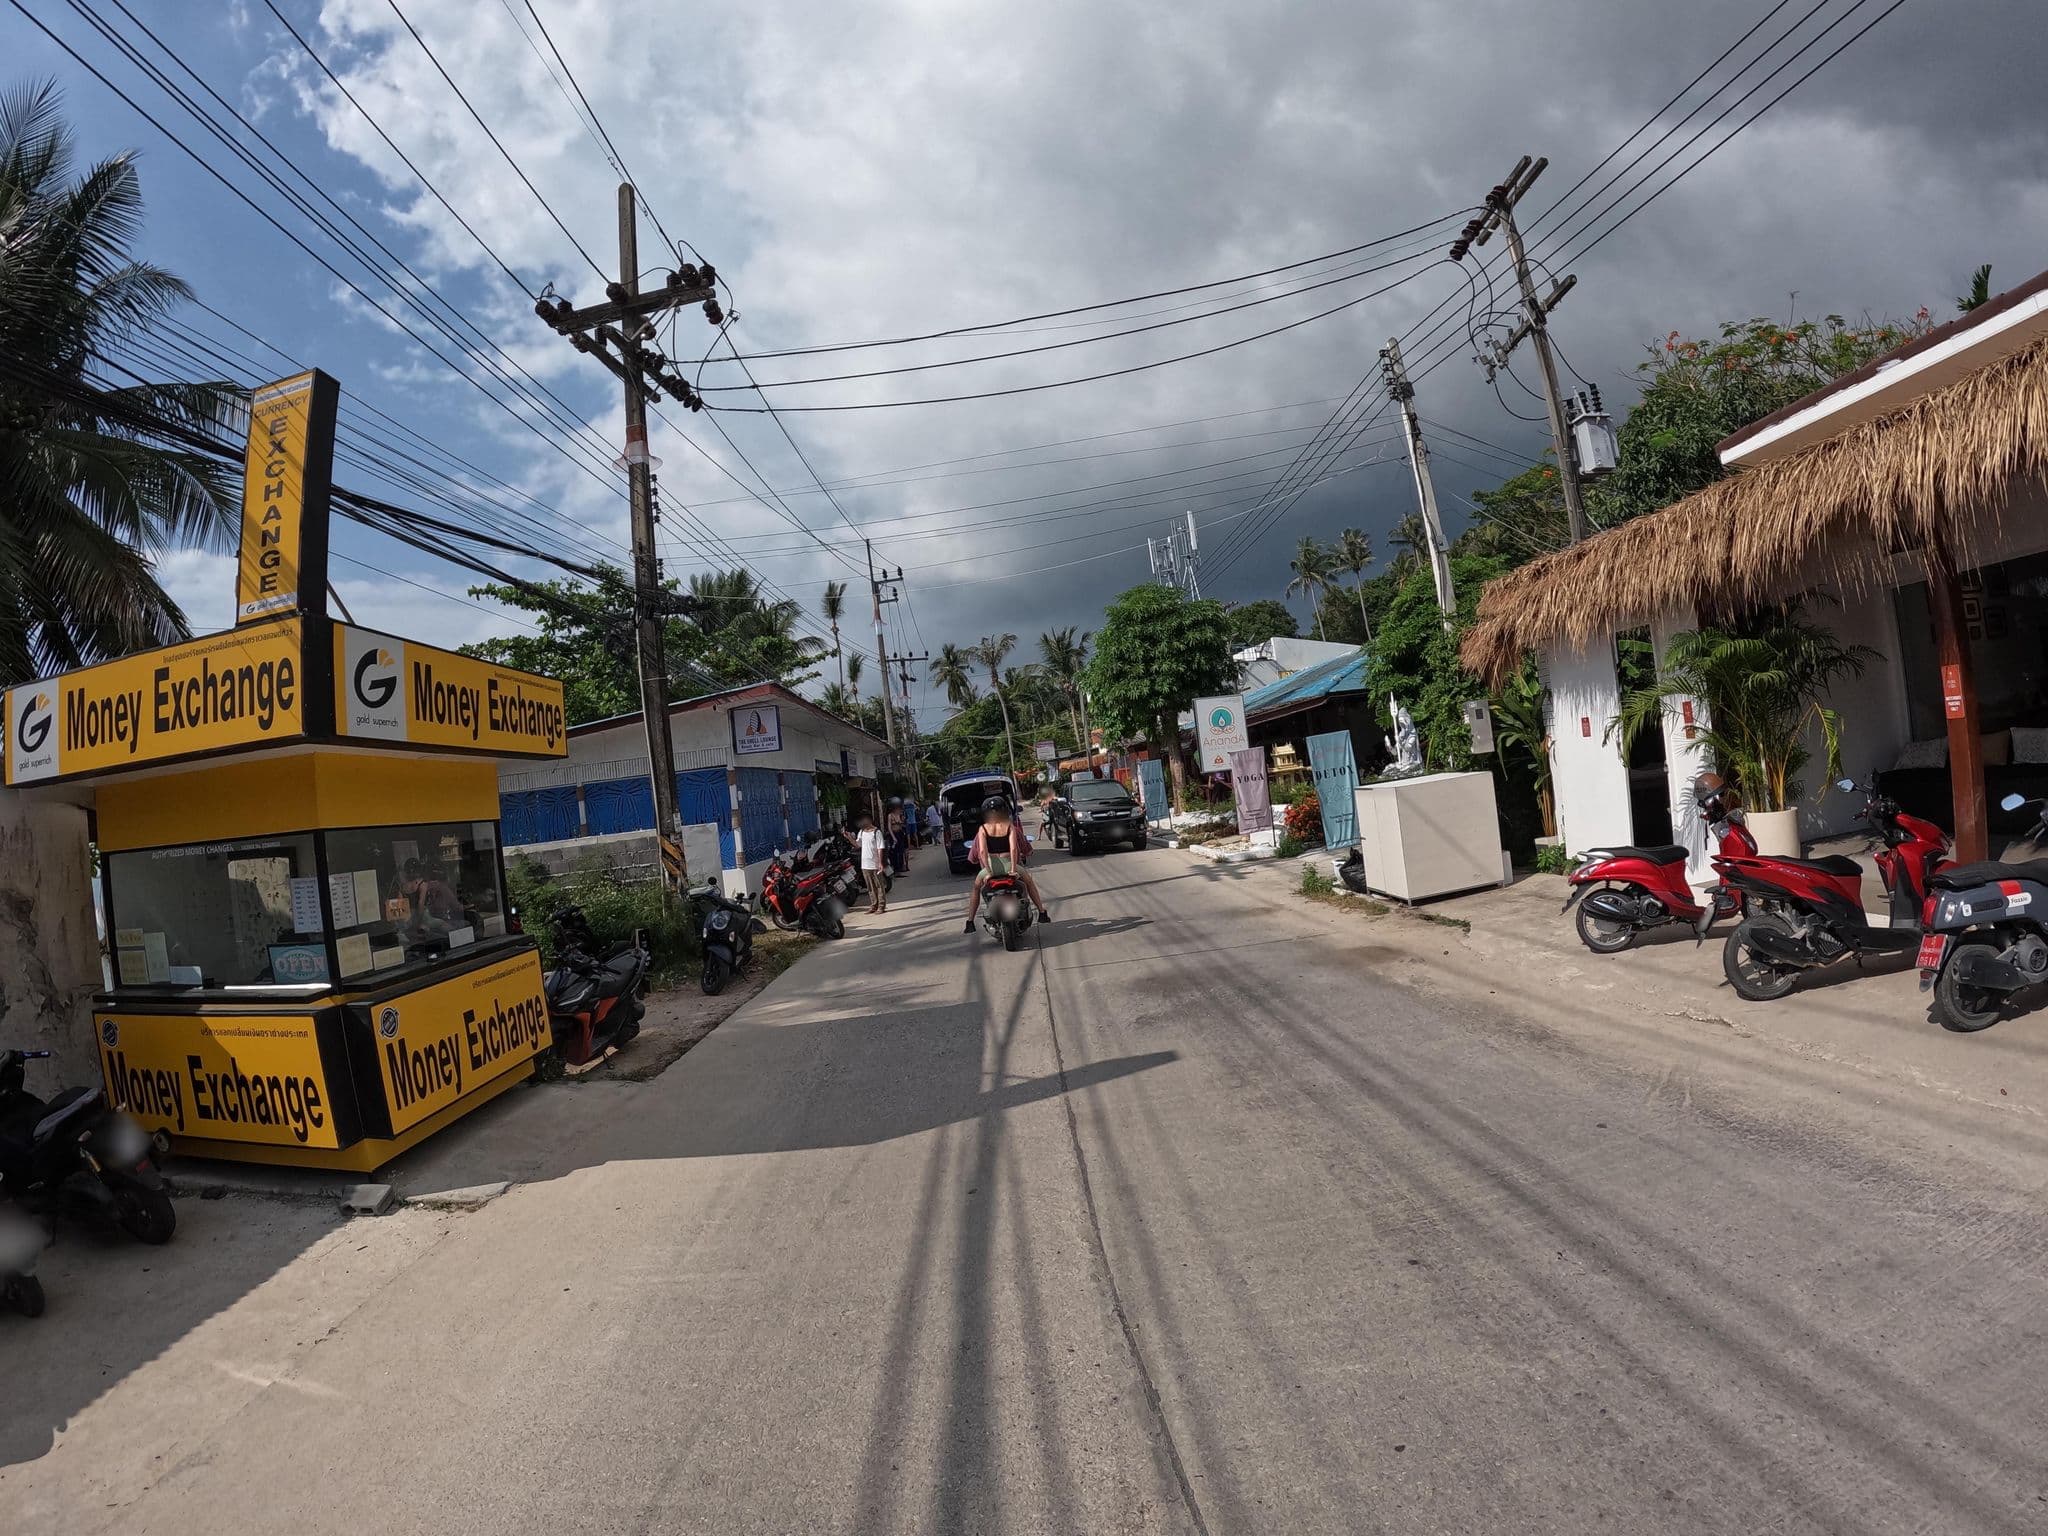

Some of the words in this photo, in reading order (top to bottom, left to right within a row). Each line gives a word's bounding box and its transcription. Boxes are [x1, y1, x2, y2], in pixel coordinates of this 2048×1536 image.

[254, 395, 309, 418] CURRENCY
[259, 415, 288, 594] EXCHANGE
[67, 688, 142, 754] Money
[154, 657, 295, 734] Exchange
[413, 661, 480, 741] Money
[487, 678, 562, 749] Exchange
[356, 713, 370, 727] gold
[19, 756, 30, 772] gold
[1315, 765, 1354, 781] DETOX
[1237, 773, 1264, 784] YOGA
[275, 955, 326, 973] OPEN
[386, 1033, 462, 1111] Money
[463, 994, 545, 1072] Exchange
[106, 1050, 185, 1132] Money
[186, 1055, 324, 1143] Exchange
